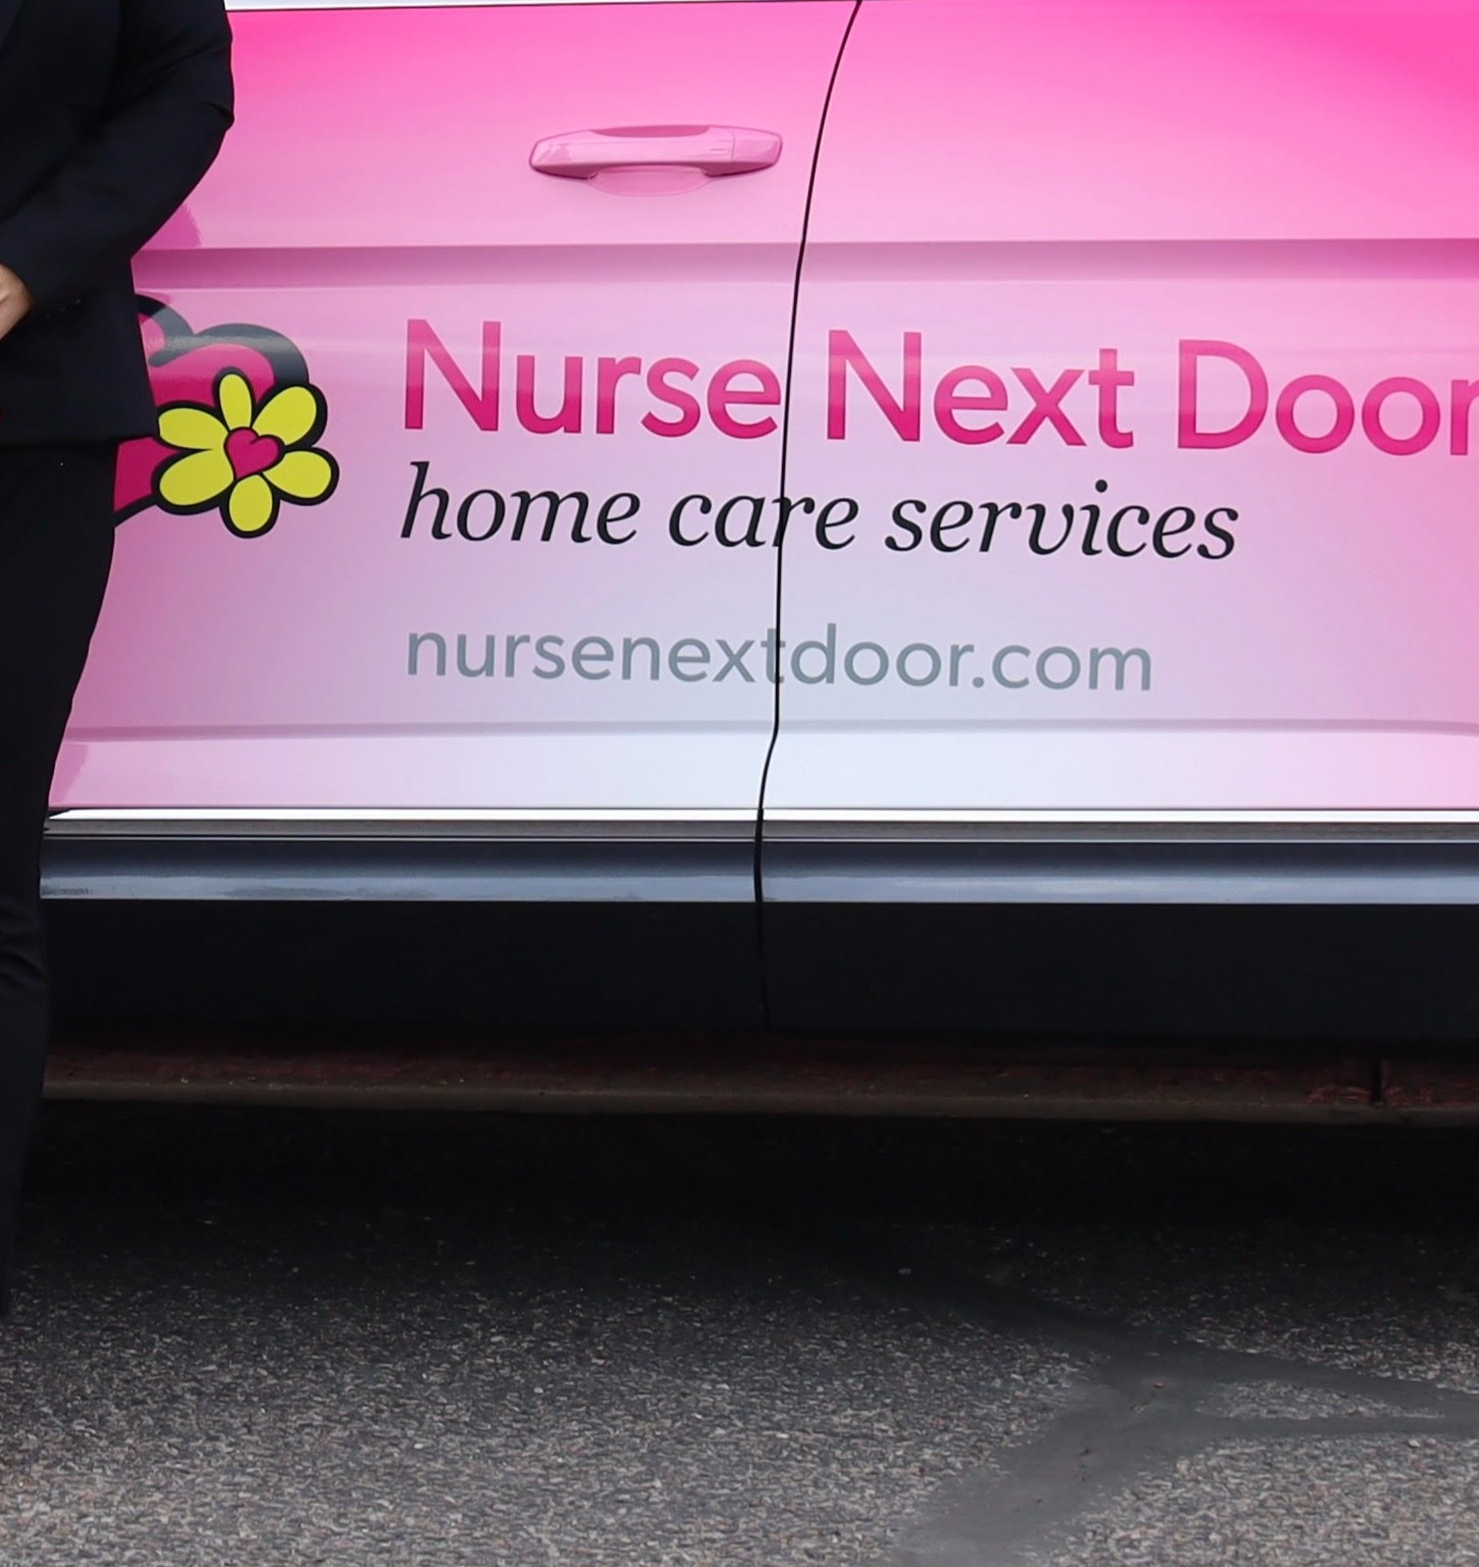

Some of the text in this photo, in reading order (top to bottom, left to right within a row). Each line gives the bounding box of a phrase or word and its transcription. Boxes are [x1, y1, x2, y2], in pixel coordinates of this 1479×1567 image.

[403, 319, 782, 440] Nurse
[826, 330, 1135, 450] Next
[399, 461, 1240, 561] home care services
[405, 623, 1153, 692] nursenextdoor.com
